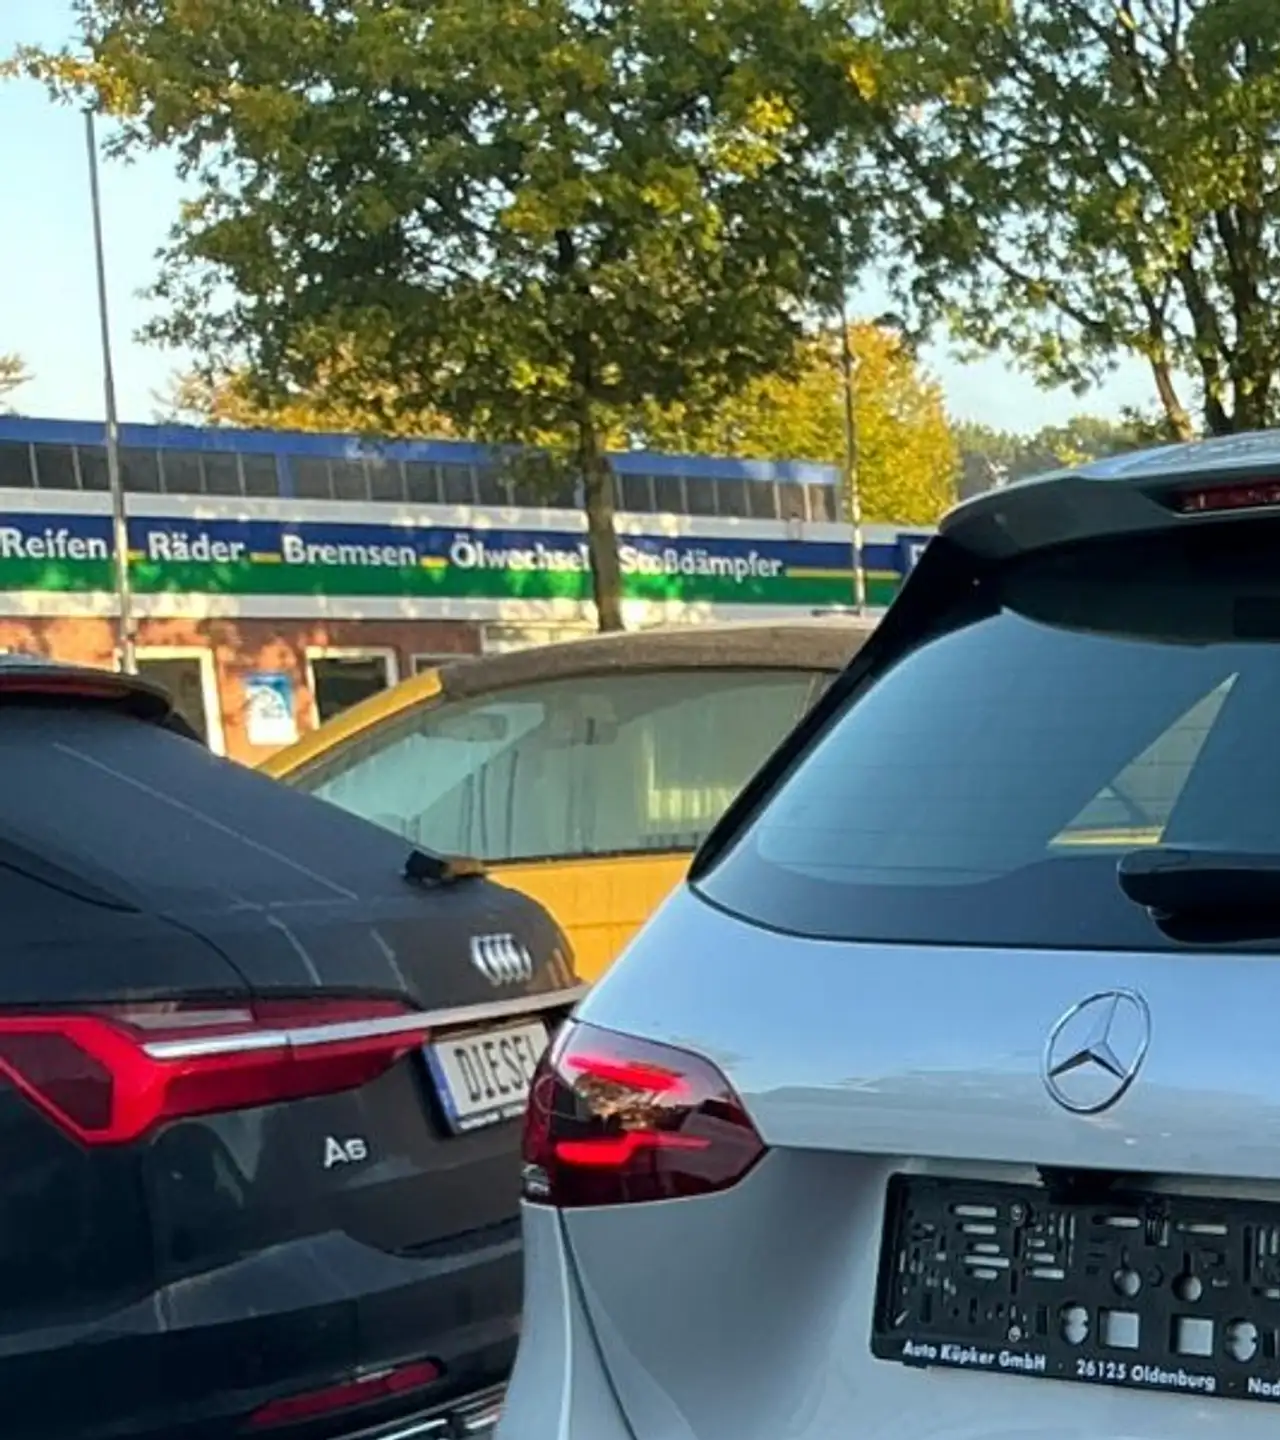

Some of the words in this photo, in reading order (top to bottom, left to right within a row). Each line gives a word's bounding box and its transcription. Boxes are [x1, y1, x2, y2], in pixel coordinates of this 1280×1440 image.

[0, 527, 108, 559] Reifen
[148, 531, 246, 562] Räder
[282, 533, 417, 568] Bremsen
[451, 532, 590, 572] Ölwechsel
[618, 545, 783, 584] Stoßdämpfer
[323, 1135, 367, 1168] A6
[902, 1339, 937, 1359] Auto
[940, 1343, 995, 1366] Küpker
[999, 1350, 1046, 1371] GmbH
[1075, 1358, 1127, 1380] 26125
[1130, 1364, 1216, 1391] Oldenburg
